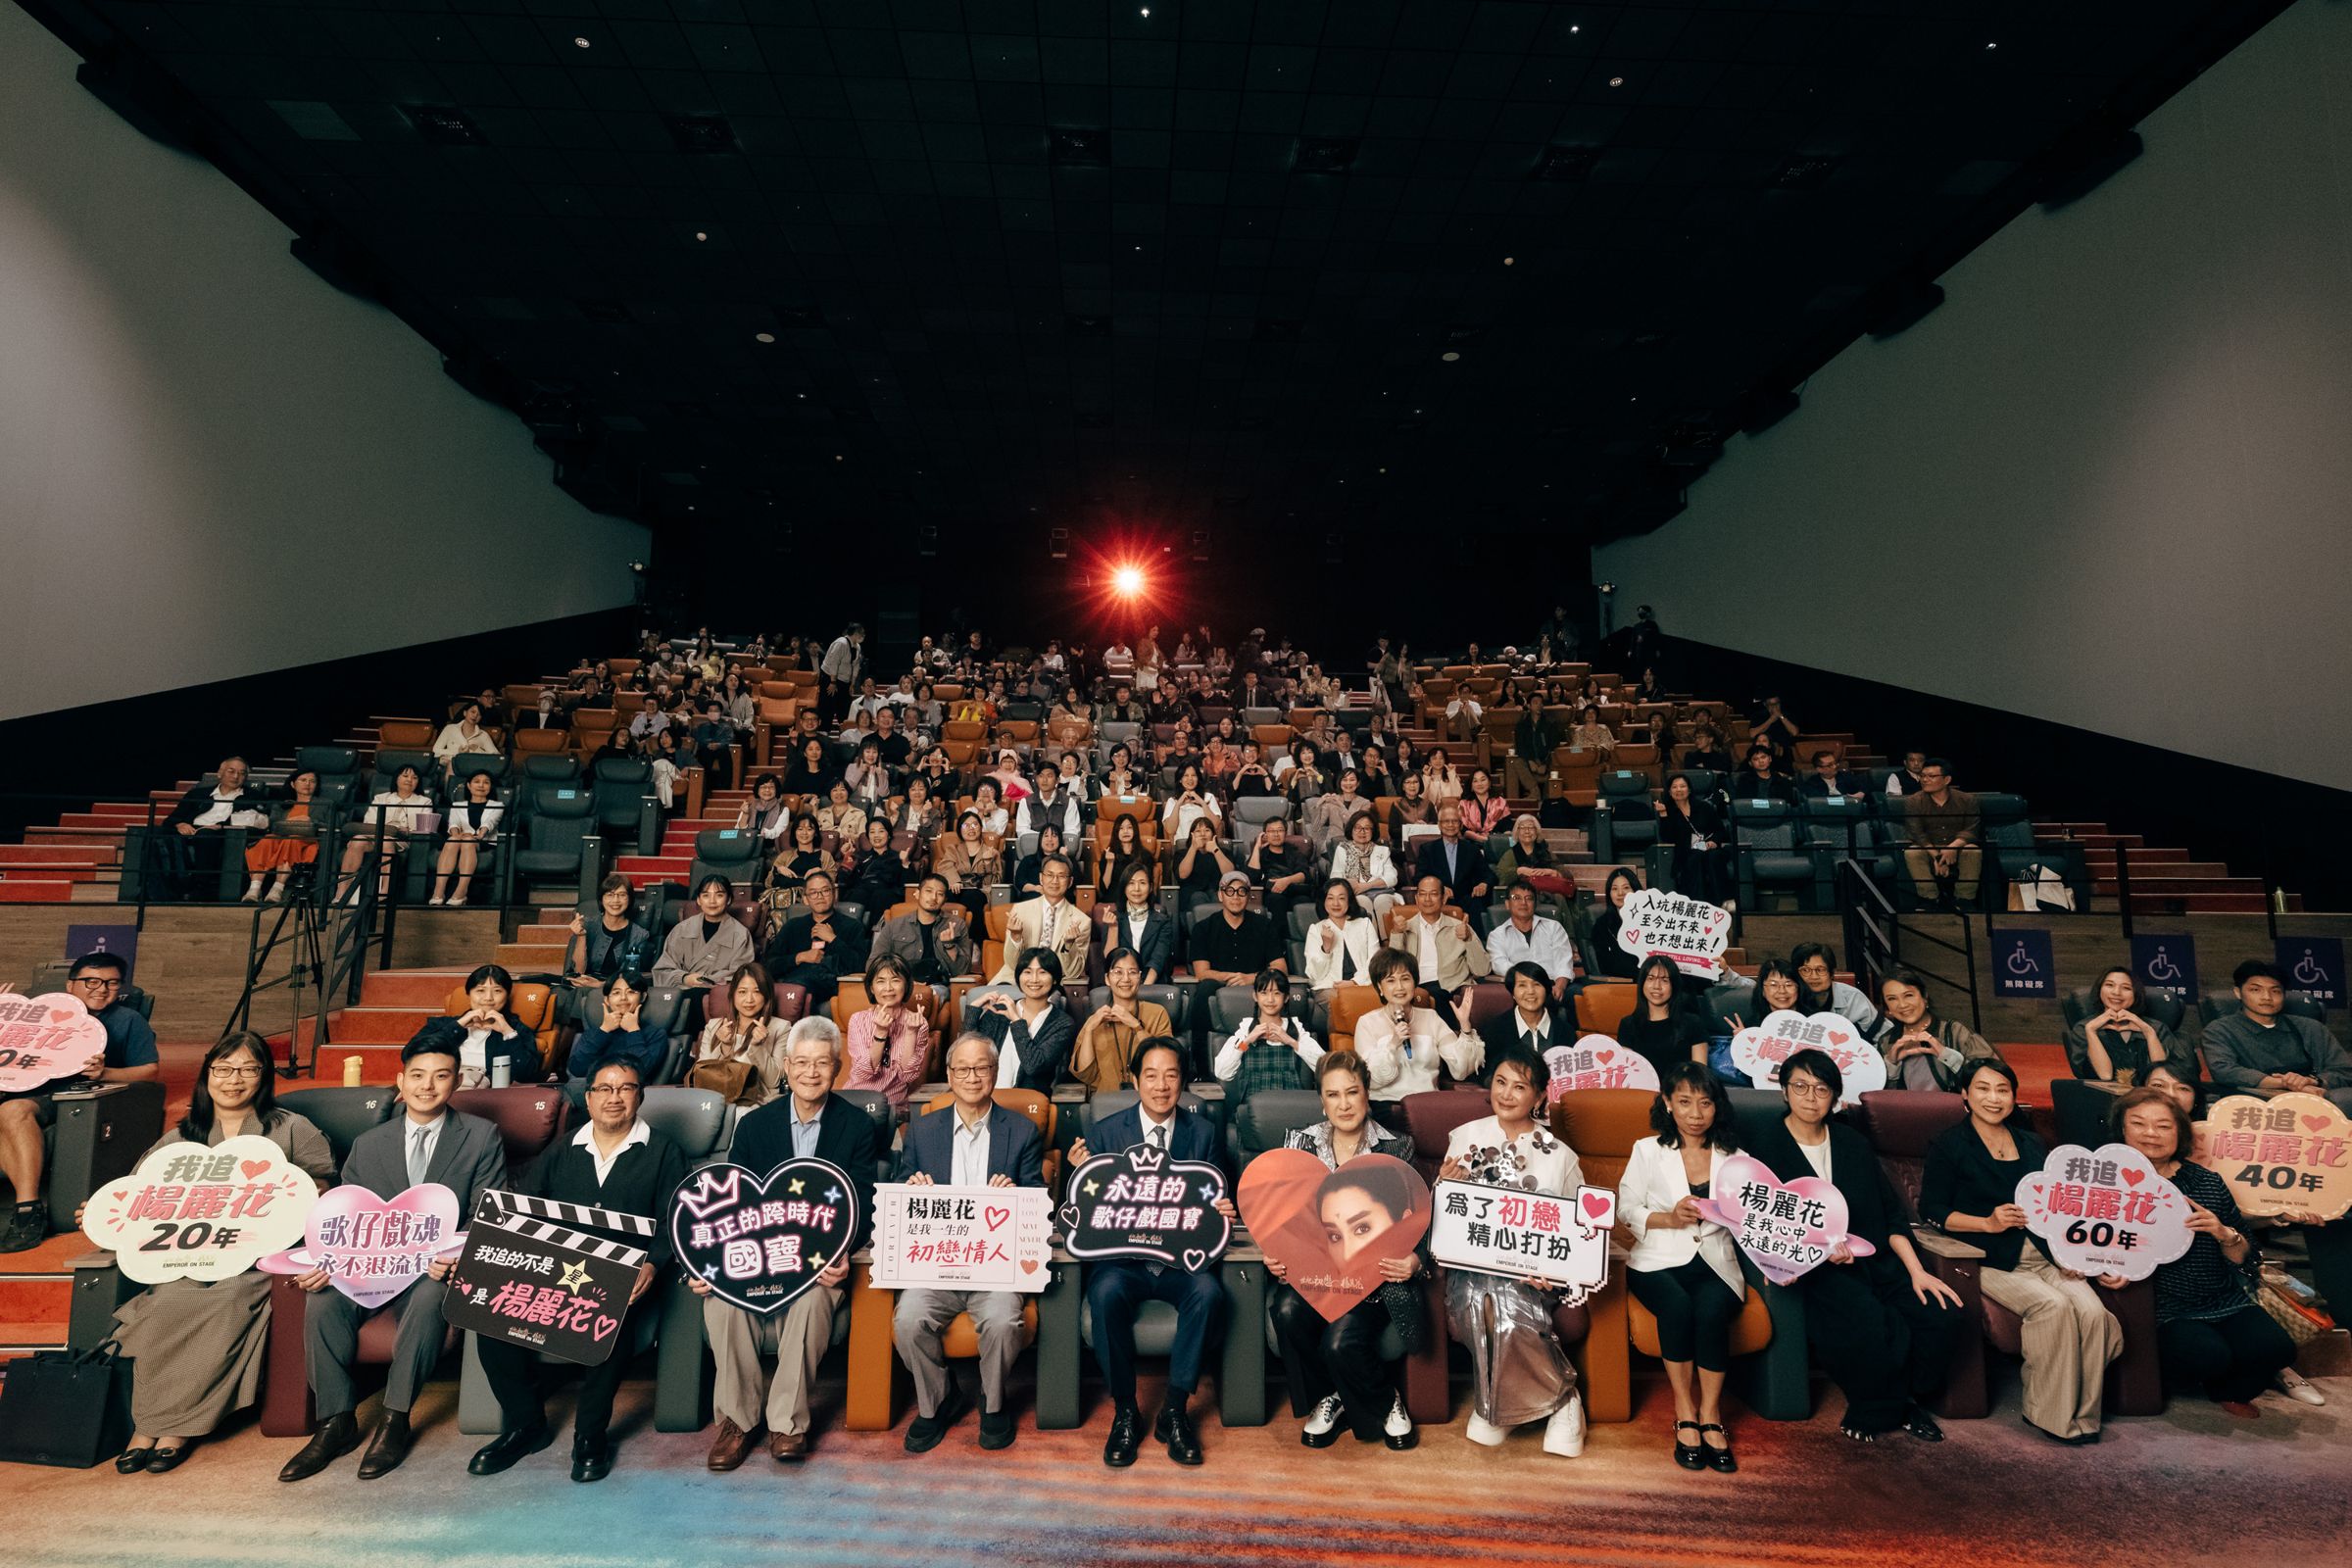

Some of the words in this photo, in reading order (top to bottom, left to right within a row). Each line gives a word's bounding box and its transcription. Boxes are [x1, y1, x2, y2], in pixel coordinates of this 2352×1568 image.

[1642, 895, 1710, 920] 入坑楊麗花
[1641, 914, 1699, 935] 至今出不來
[786, 992, 795, 1001] 14
[915, 993, 923, 1002] 13
[2005, 980, 2044, 990] 無障礙席
[0, 1002, 49, 1023] 我追
[0, 1023, 79, 1051] 麗花
[1778, 1019, 1827, 1044] 我追
[1553, 1050, 1594, 1075] 我追
[1757, 1036, 1859, 1076] 楊花
[366, 1100, 377, 1109] 16
[534, 1101, 546, 1110] 15
[701, 1102, 711, 1111] 14
[866, 1103, 876, 1112] 13
[1028, 1104, 1038, 1113] 12
[1189, 1104, 1198, 1113] 11
[105, 1125, 111, 1137] 2
[2231, 1106, 2296, 1132] 我追
[2212, 1130, 2352, 1168] 楊麗花
[163, 1154, 238, 1183] 我追
[2065, 1157, 2118, 1186] 我追
[2234, 1164, 2324, 1193] 40年
[1103, 1174, 1186, 1202] 永遠的
[126, 1183, 282, 1221] 楊麗花
[906, 1198, 976, 1220] 楊麗花
[1739, 1182, 1826, 1229] 楊麗花
[2047, 1182, 2160, 1225] 楊麗花
[319, 1211, 441, 1249] 歌仔戲魂
[691, 1201, 836, 1248] 真正的跨時代
[906, 1224, 969, 1236] 是我一生的
[1091, 1205, 1203, 1231] 歌仔戲國寶
[1742, 1213, 1806, 1241] 是我心中
[139, 1222, 241, 1251] 20年
[1467, 1222, 1571, 1261] 精心打扮
[1740, 1231, 1804, 1263] 永遠的光
[2066, 1220, 2137, 1250] 60年
[316, 1252, 437, 1277] 永不退流行
[724, 1235, 802, 1279] 國寶
[906, 1239, 1010, 1264] 初戀情人
[474, 1245, 555, 1275] 我追的不是
[566, 1269, 582, 1285] 星
[469, 1288, 488, 1305] 是
[489, 1280, 600, 1332] 楊麗花
